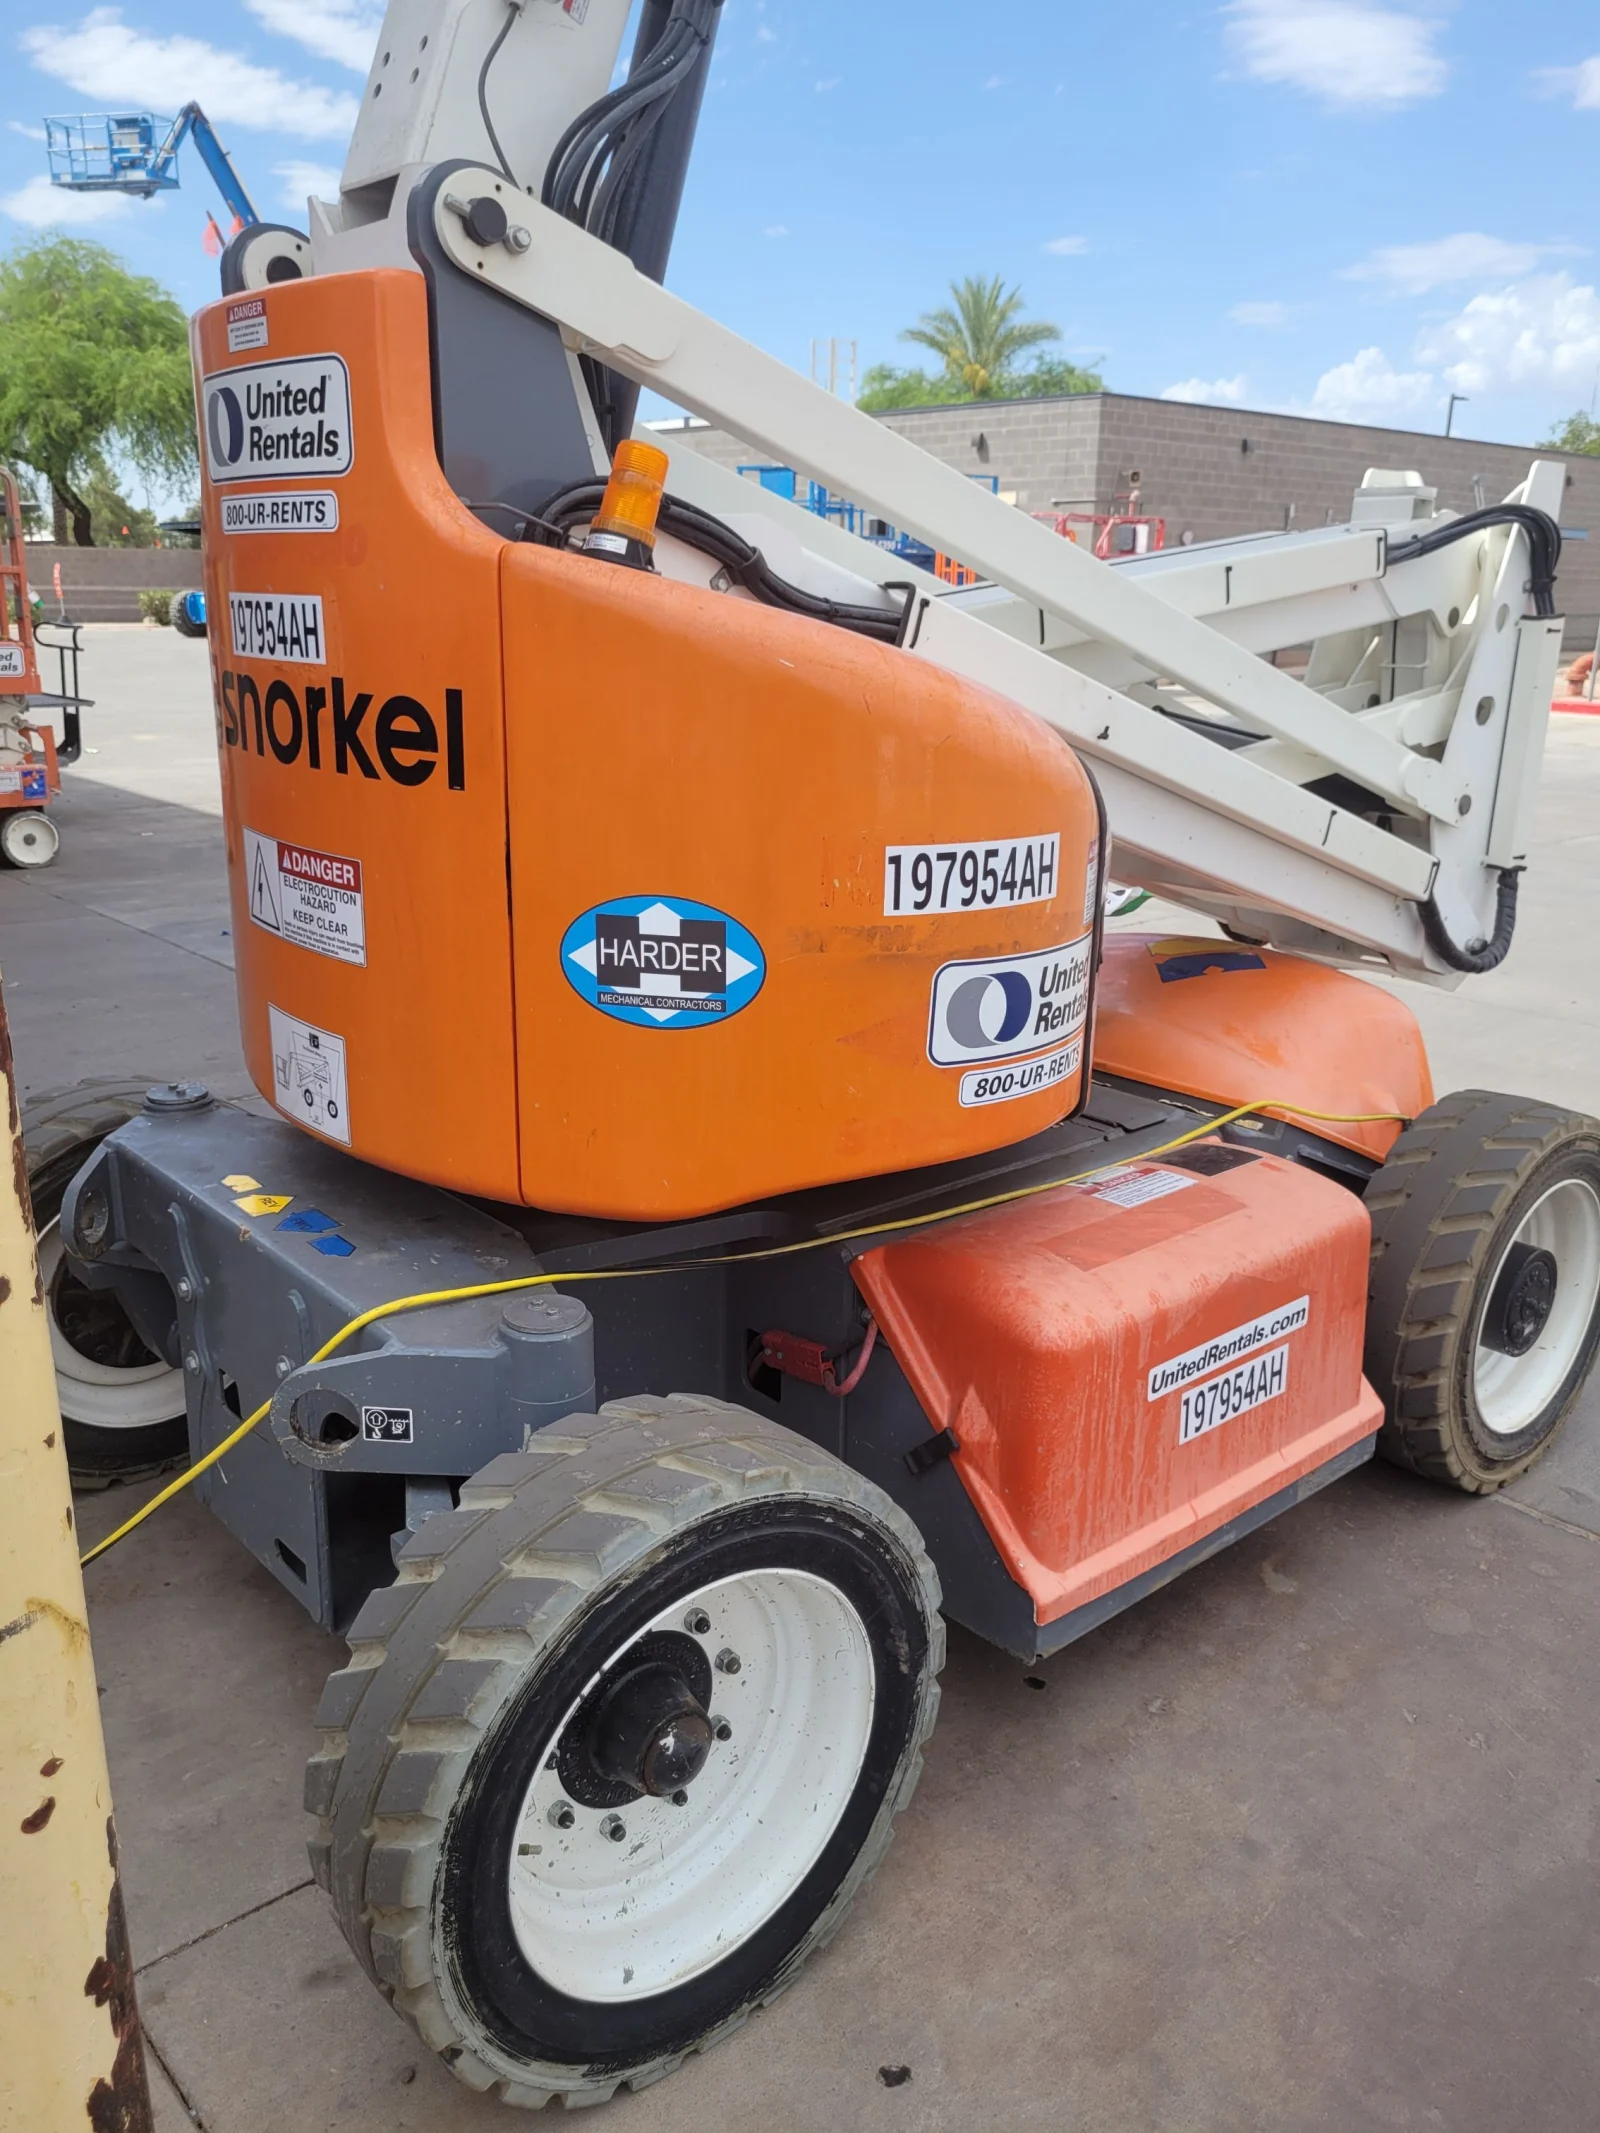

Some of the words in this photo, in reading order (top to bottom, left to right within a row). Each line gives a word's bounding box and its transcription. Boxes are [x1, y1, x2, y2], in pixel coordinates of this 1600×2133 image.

[234, 301, 263, 320] DANGER
[246, 375, 327, 420] United
[250, 420, 339, 462] Rentals
[226, 500, 326, 526] 800-UR-RENTS
[231, 599, 320, 659] 197954AH
[222, 670, 465, 791] snorkel
[292, 851, 354, 886] DANGER
[888, 841, 1055, 911] 197954AH
[284, 875, 357, 906] ELECTROCUTION
[300, 893, 336, 914] HAZARD
[293, 908, 314, 925] KEEP
[317, 917, 348, 936] CLEAR
[600, 937, 722, 973] HARDER
[601, 994, 654, 1007] MECHANICAL
[656, 998, 722, 1011] CONTRACTORS
[974, 1043, 1081, 1098] 800-UR-RENTS
[1151, 1307, 1306, 1394] UnitedRentals.com
[1182, 1351, 1284, 1439] 197954AH
